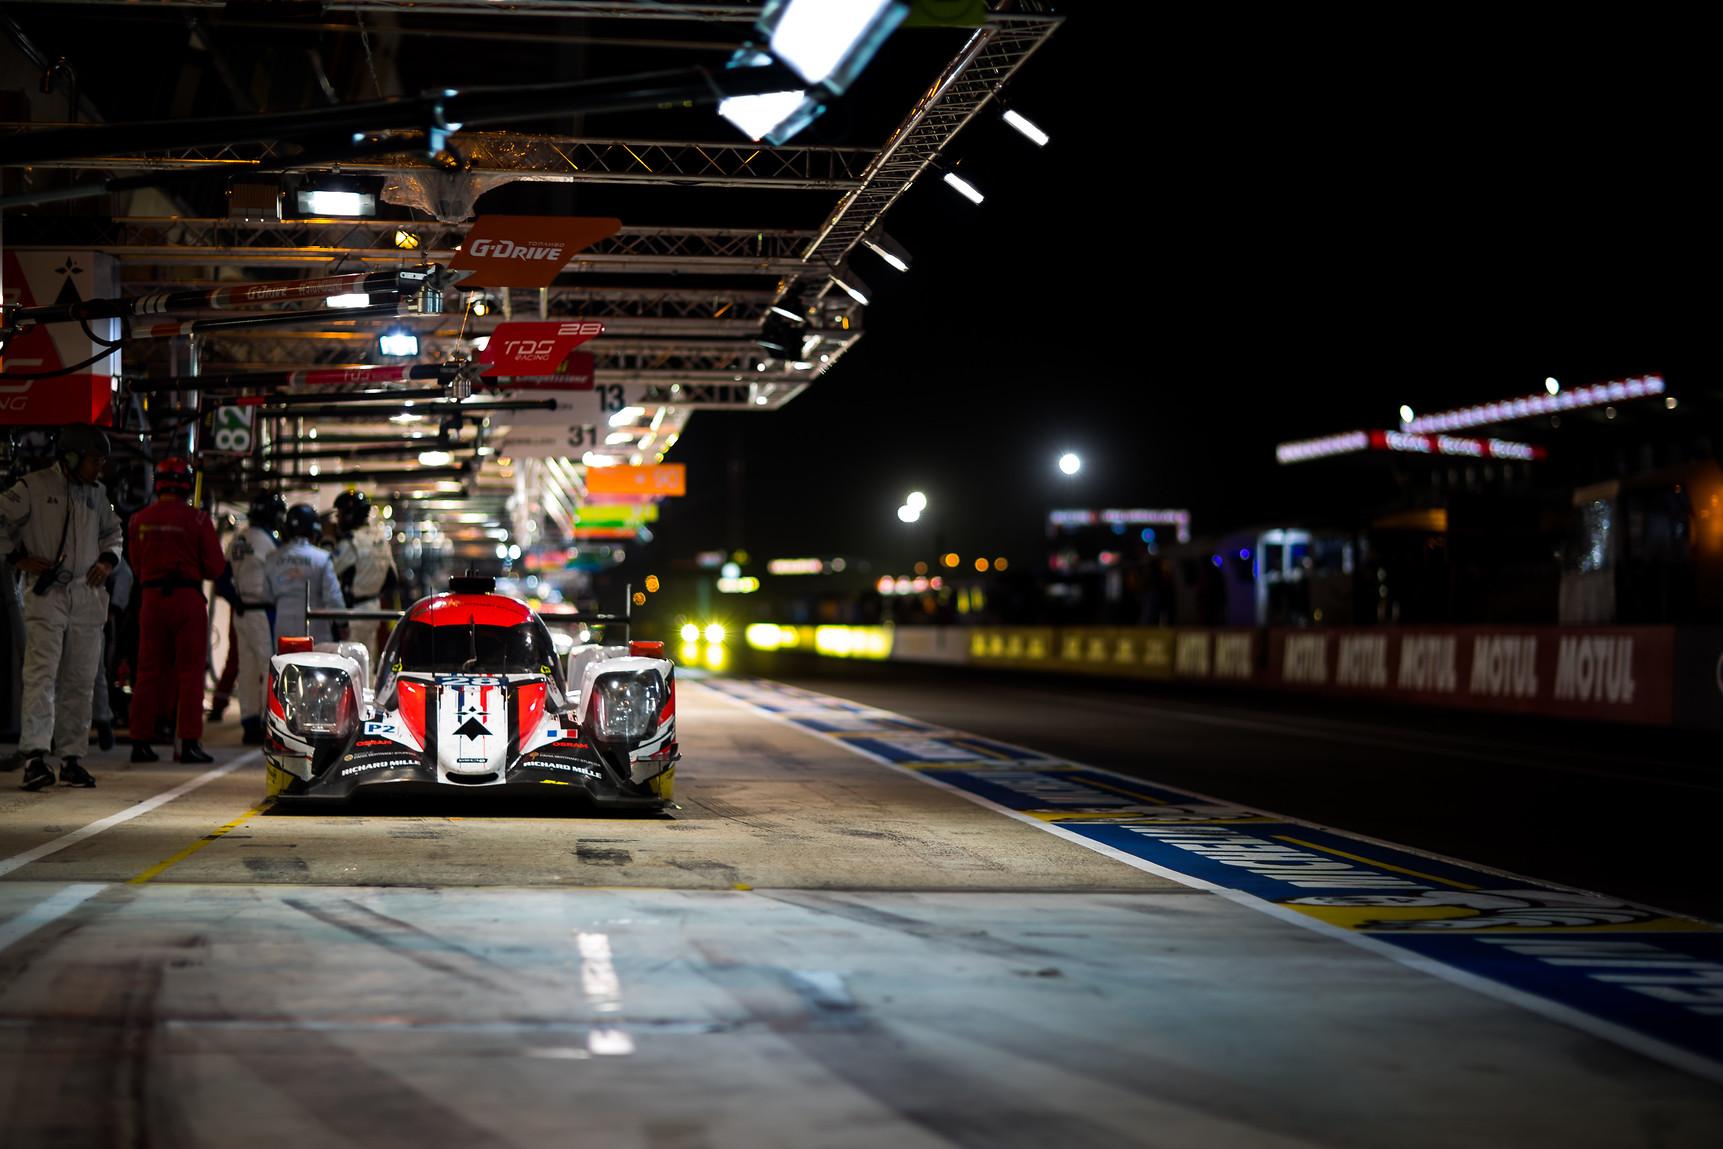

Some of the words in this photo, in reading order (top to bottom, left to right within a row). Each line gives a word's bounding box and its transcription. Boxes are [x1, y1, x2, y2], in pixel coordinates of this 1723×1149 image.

[557, 323, 602, 336] 28
[504, 340, 556, 355] TDS
[595, 384, 625, 412] 13
[215, 405, 252, 452] 82
[568, 426, 597, 447] 31
[1396, 633, 1458, 695] MOTUL
[1469, 634, 1539, 699] MOTUL
[1554, 635, 1635, 704] MOTUL
[442, 677, 501, 686] 28
[368, 724, 396, 733] P2
[551, 741, 590, 749] OSRAM
[341, 761, 388, 776] RICHARD
[389, 759, 421, 767] MILLE
[523, 761, 571, 770] RICHARD
[572, 766, 602, 779] MILLE
[1119, 825, 1437, 890] MICHELIN
